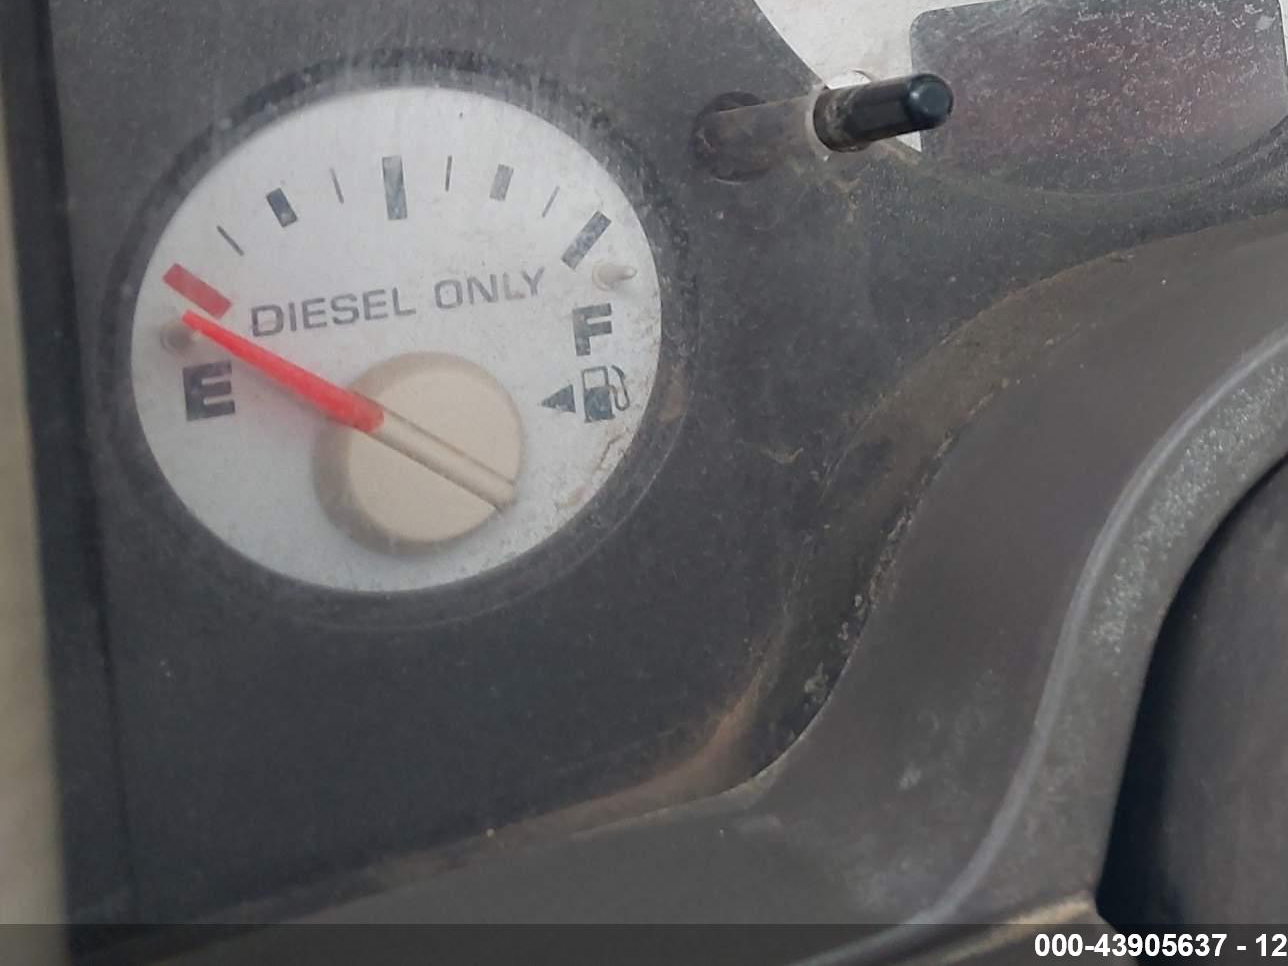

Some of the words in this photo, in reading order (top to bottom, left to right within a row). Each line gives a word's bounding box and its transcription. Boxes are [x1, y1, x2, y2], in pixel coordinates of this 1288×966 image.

[250, 287, 417, 338] DIESEL
[434, 267, 545, 310] ONLY
[572, 303, 613, 356] F
[183, 361, 235, 422] E
